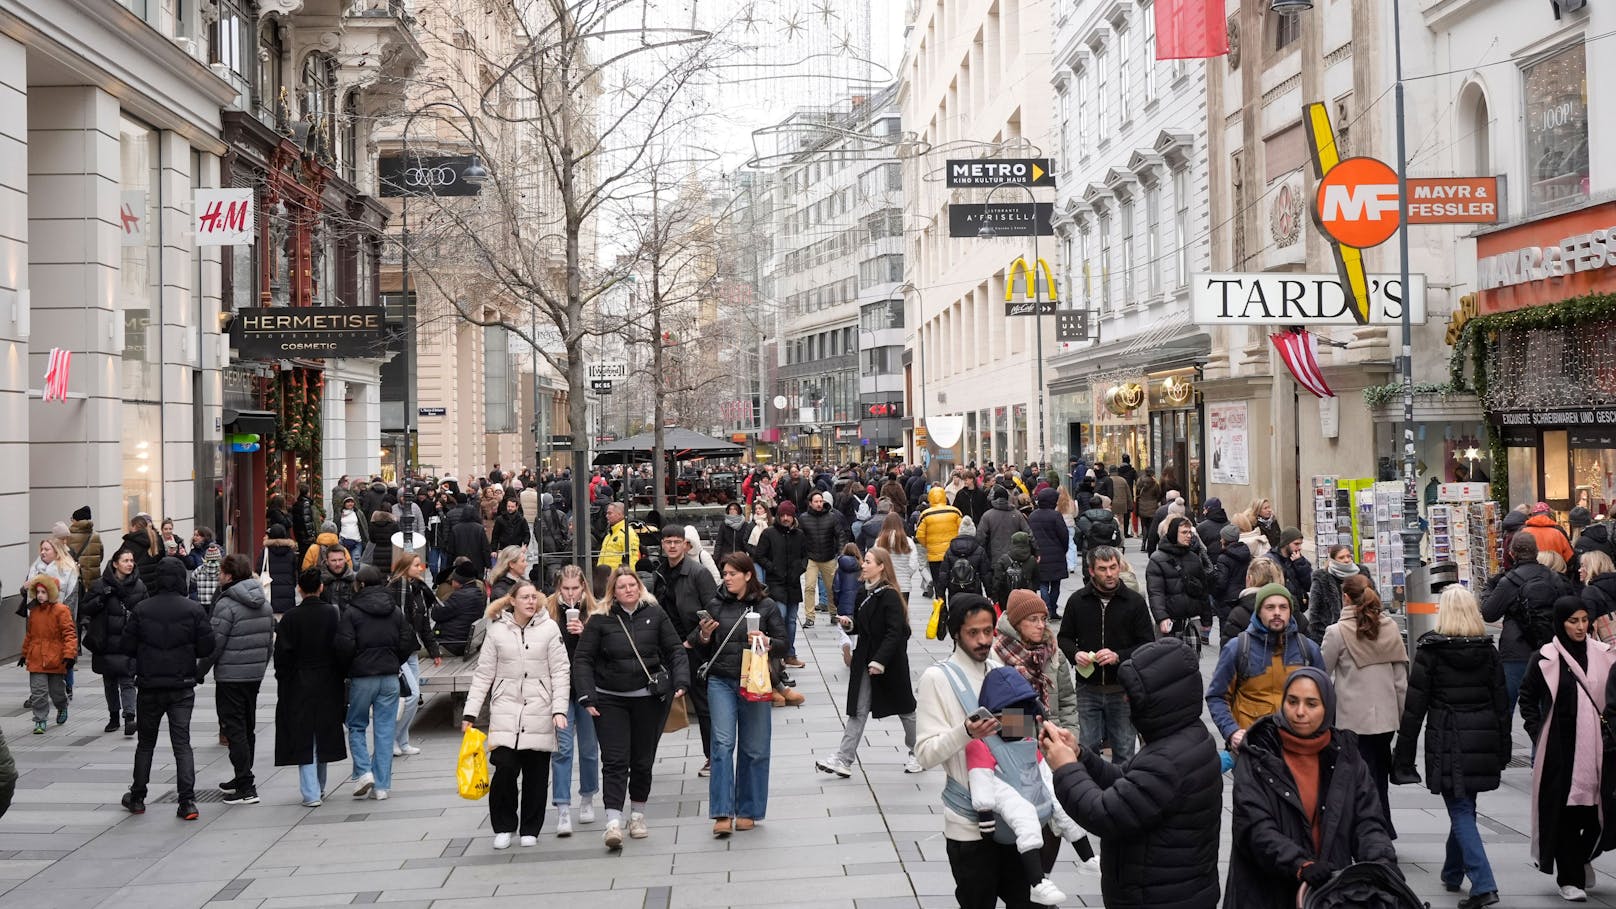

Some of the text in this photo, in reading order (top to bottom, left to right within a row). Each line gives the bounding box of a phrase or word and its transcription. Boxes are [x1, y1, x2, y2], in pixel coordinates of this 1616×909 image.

[1543, 103, 1573, 131] JOOP!
[953, 163, 1027, 177] METRO
[1414, 185, 1488, 199] MAYR &
[1322, 184, 1399, 222] MF
[1408, 203, 1495, 217] FESSLER
[199, 200, 248, 234] H&M
[1477, 246, 1541, 290] MAYR
[1540, 246, 1564, 278] &
[1207, 279, 1403, 319] TARD'S
[243, 315, 379, 329] HERMETISE
[281, 342, 337, 350] COSMETIC
[1503, 414, 1531, 424] EXQUISITE
[1532, 411, 1579, 424] SCHREIBWAREN
[1580, 411, 1594, 423] UND
